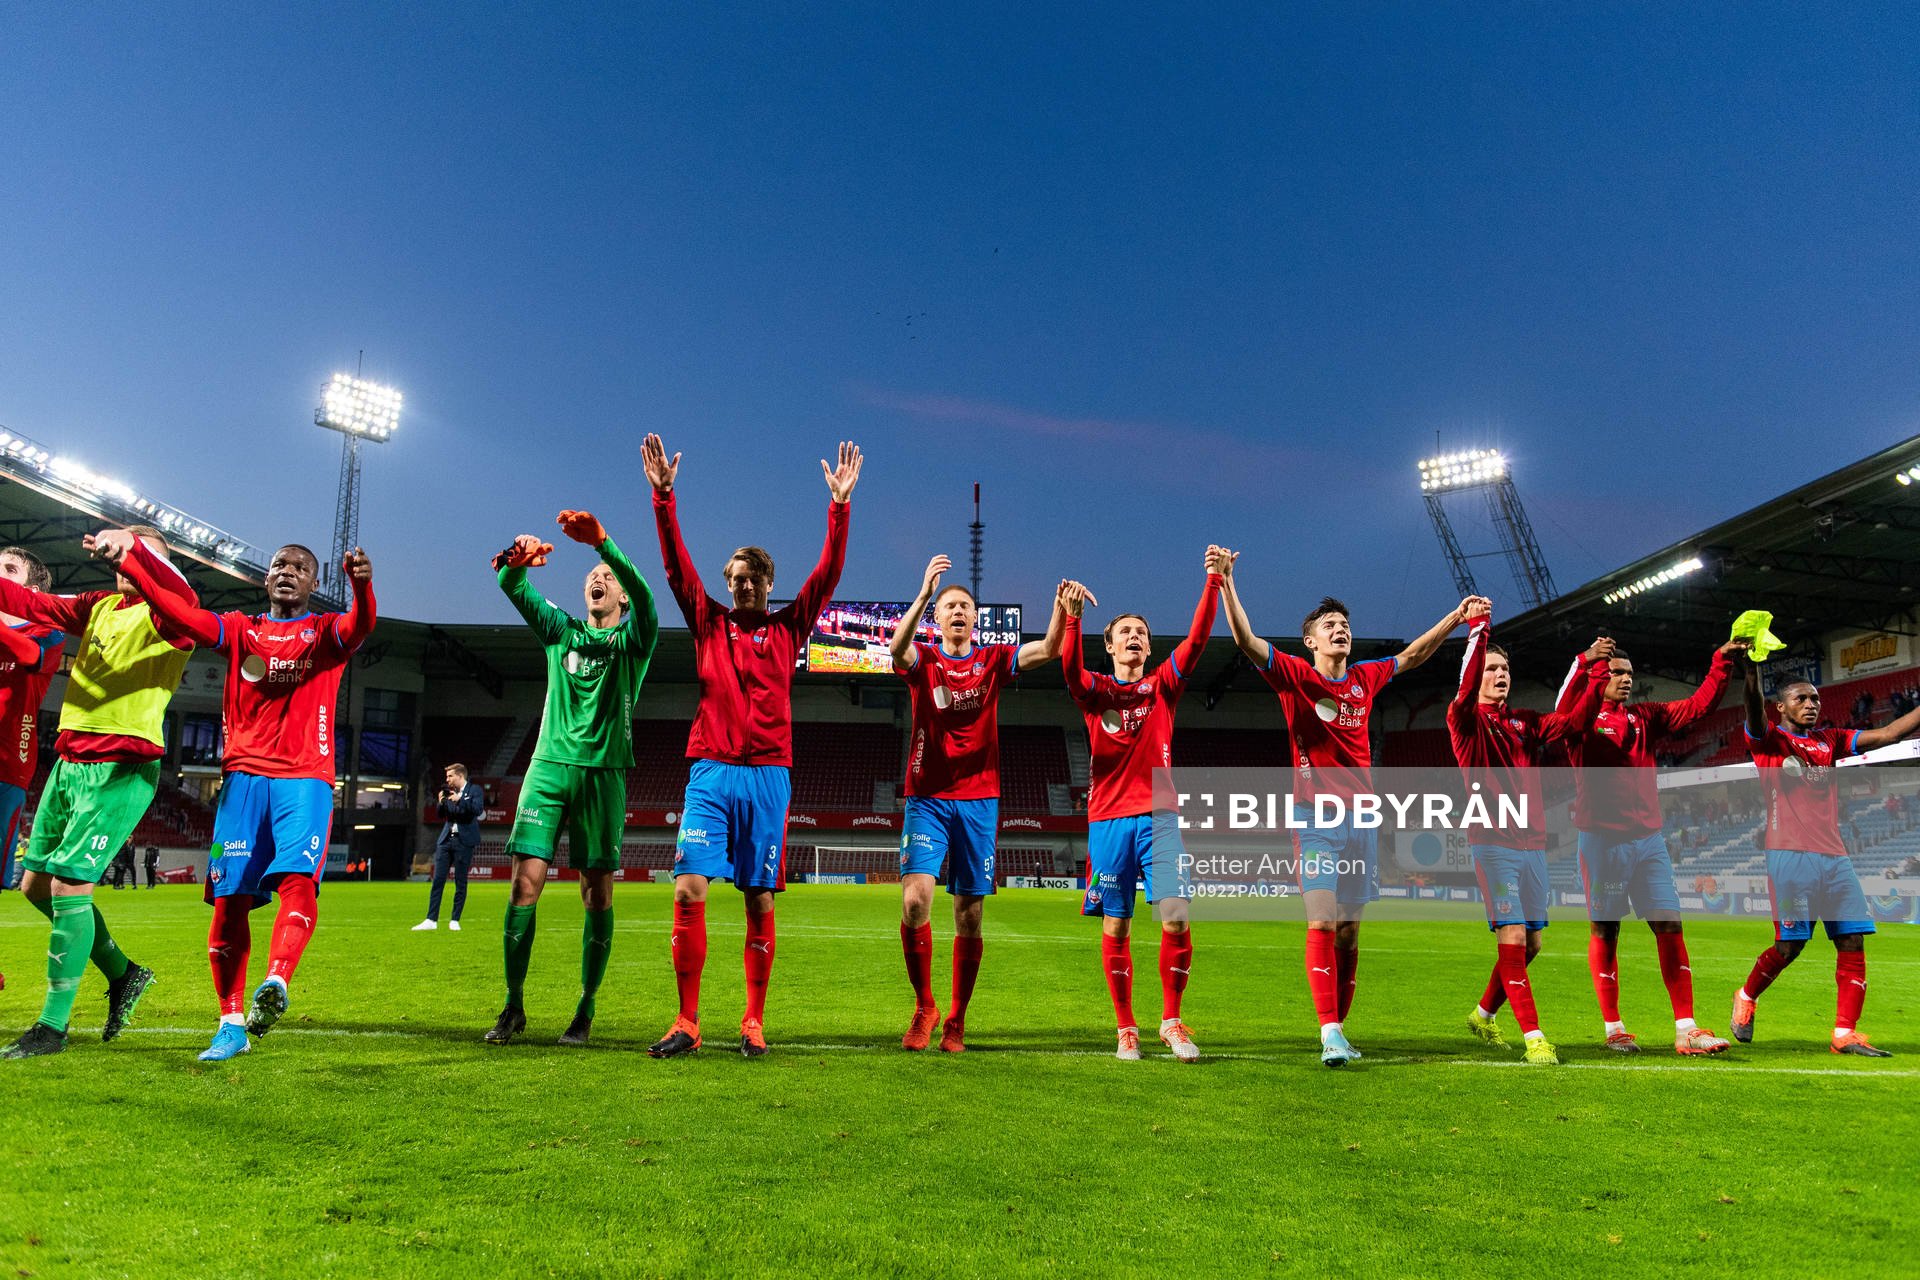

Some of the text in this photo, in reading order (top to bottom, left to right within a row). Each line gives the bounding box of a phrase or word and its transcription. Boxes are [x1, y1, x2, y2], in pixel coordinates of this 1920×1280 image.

[983, 616, 991, 627] 2
[1007, 617, 1013, 627] 1
[981, 631, 1016, 645] 92:39
[269, 656, 313, 671] Resurs
[268, 670, 302, 683] Bank
[951, 685, 988, 701] Resurs
[953, 699, 981, 712] Bank
[1340, 702, 1366, 716] Resur
[319, 704, 328, 741] akea
[20, 714, 36, 749] akea
[912, 742, 925, 774] akea
[520, 806, 539, 818] Solid
[788, 814, 817, 825] MLÖSA
[852, 815, 892, 827] RAMLÖSA
[1002, 818, 1042, 829] RAMLÖSA
[686, 828, 707, 838] Solid
[91, 834, 109, 850] 18
[223, 840, 247, 850] Solid
[310, 835, 320, 850] 9
[769, 845, 777, 860] 3
[1100, 872, 1118, 883] Solid
